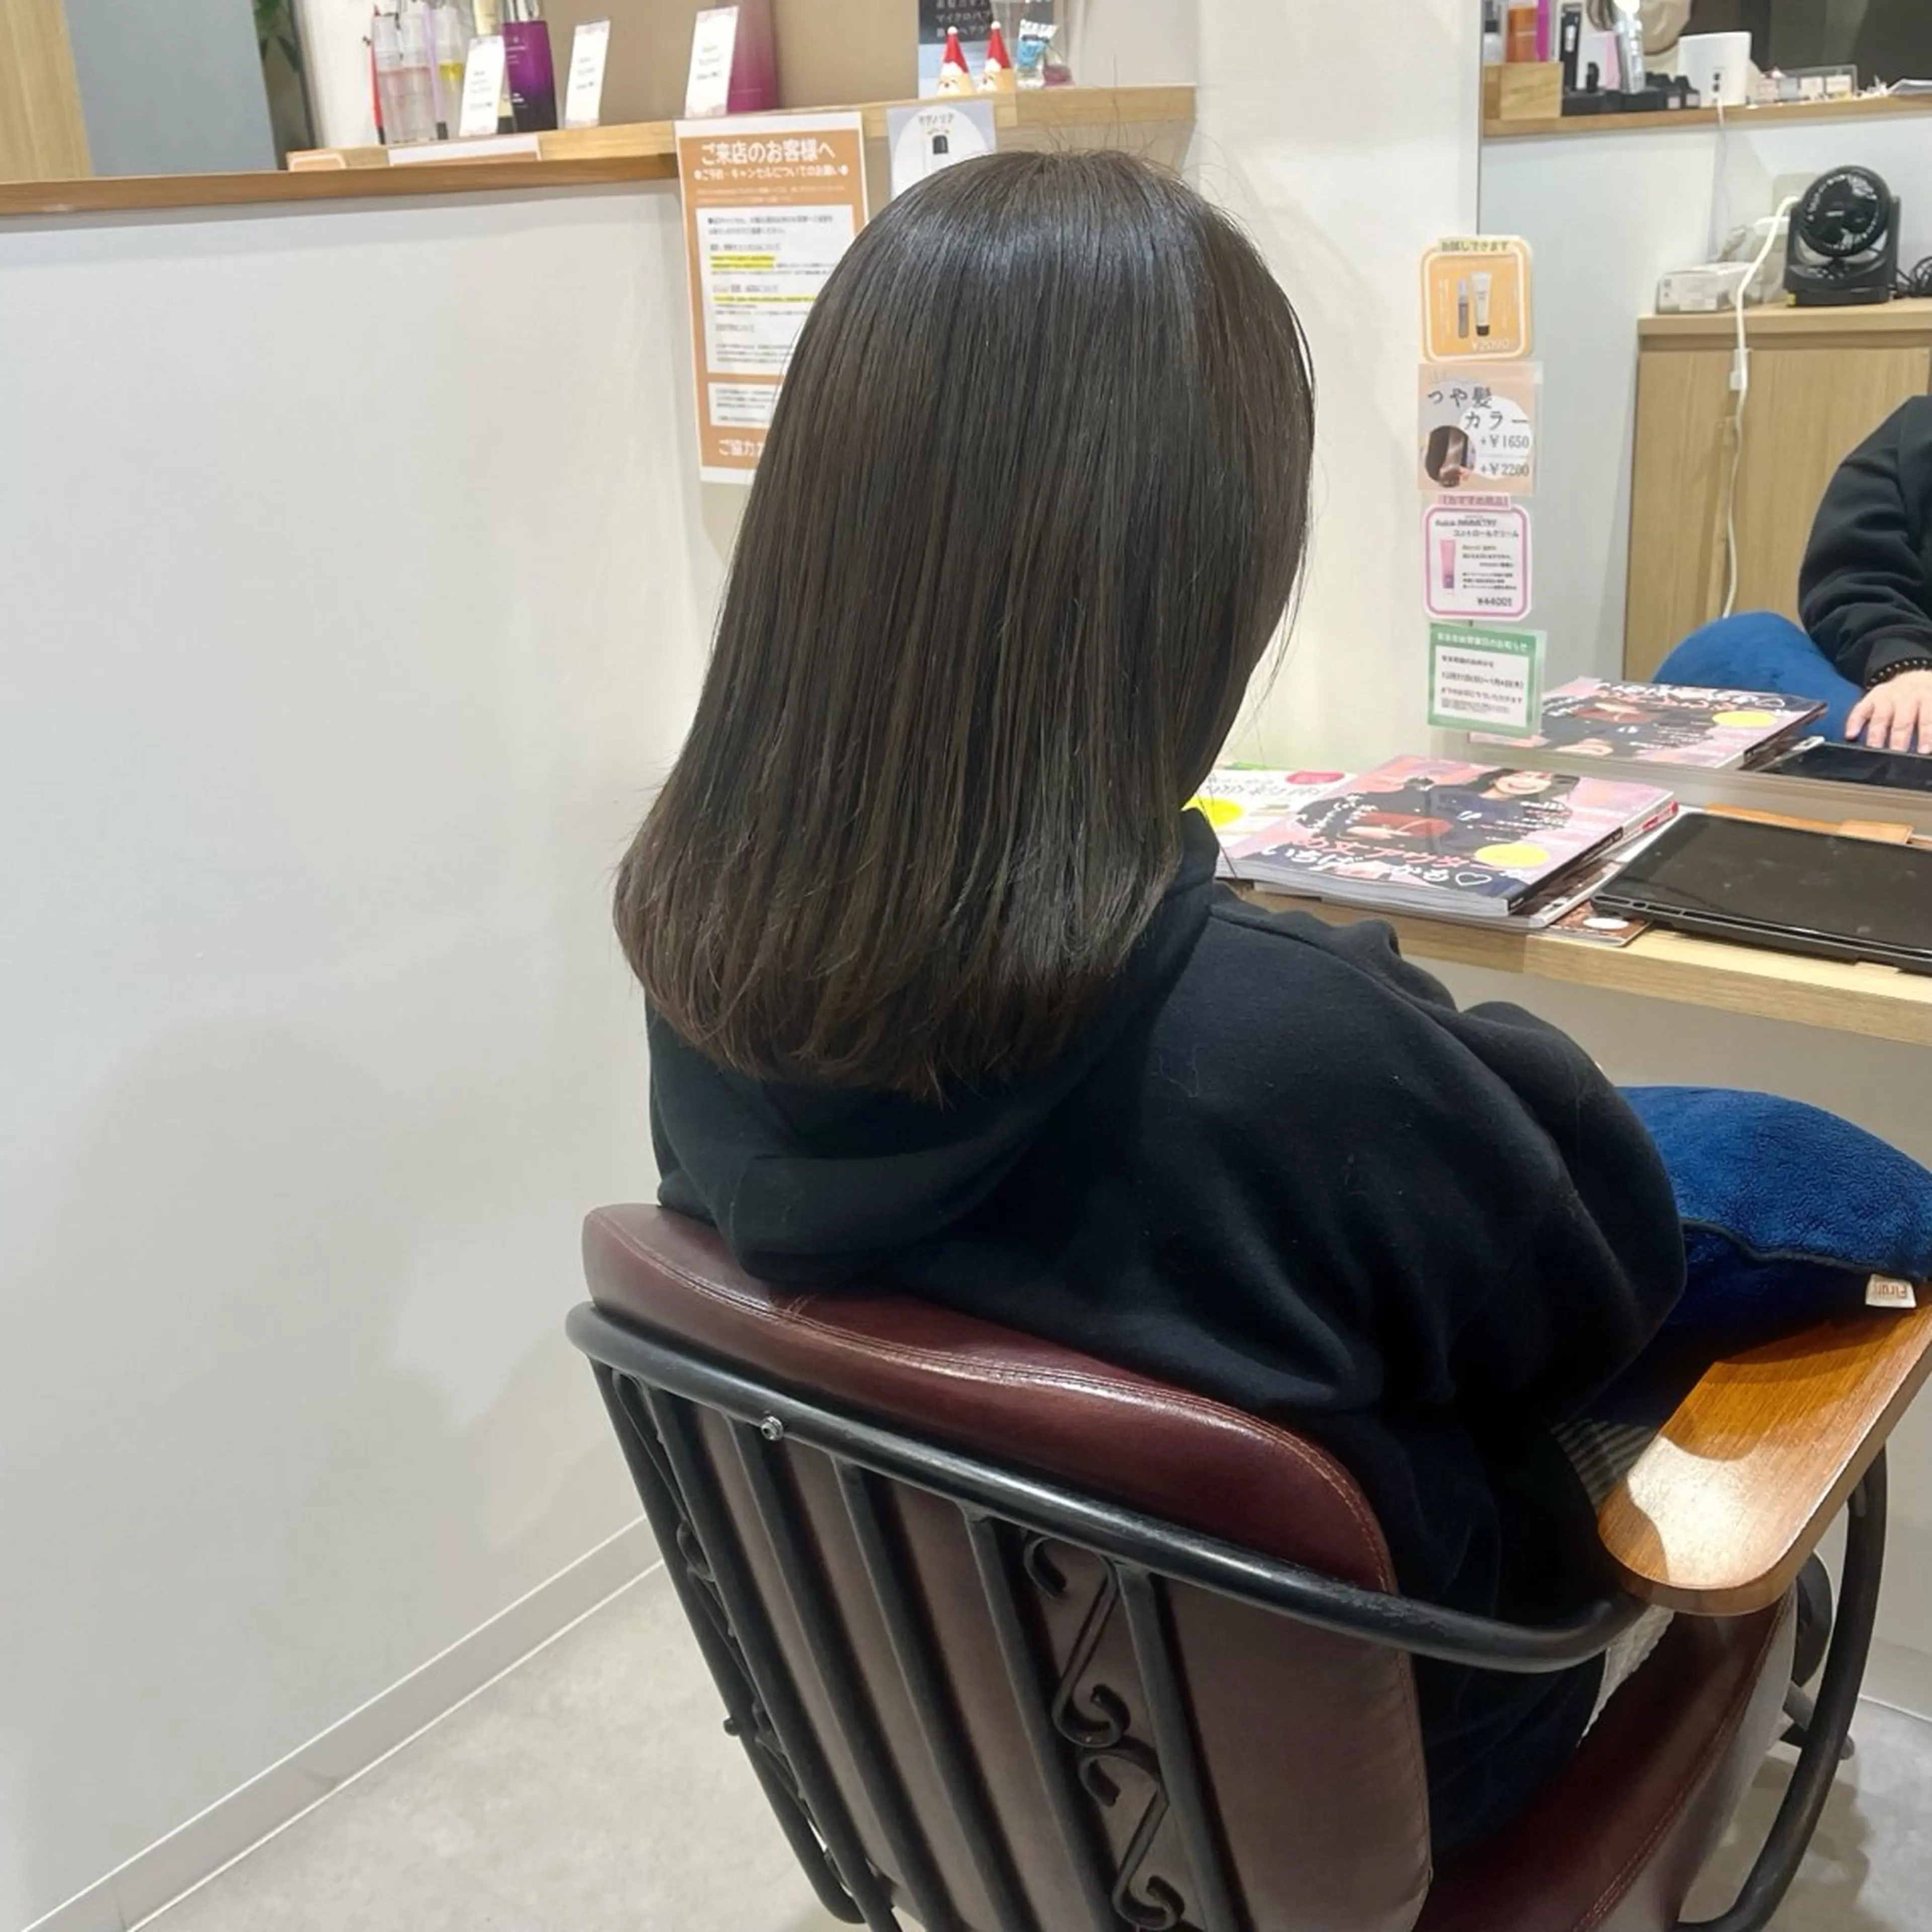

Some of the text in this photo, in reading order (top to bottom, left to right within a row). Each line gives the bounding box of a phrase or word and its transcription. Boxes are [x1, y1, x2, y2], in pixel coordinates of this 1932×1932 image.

[701, 139, 836, 166] ご来店のお客様へ
[1427, 385, 1493, 409] つや髪
[1464, 410, 1530, 431] カラー
